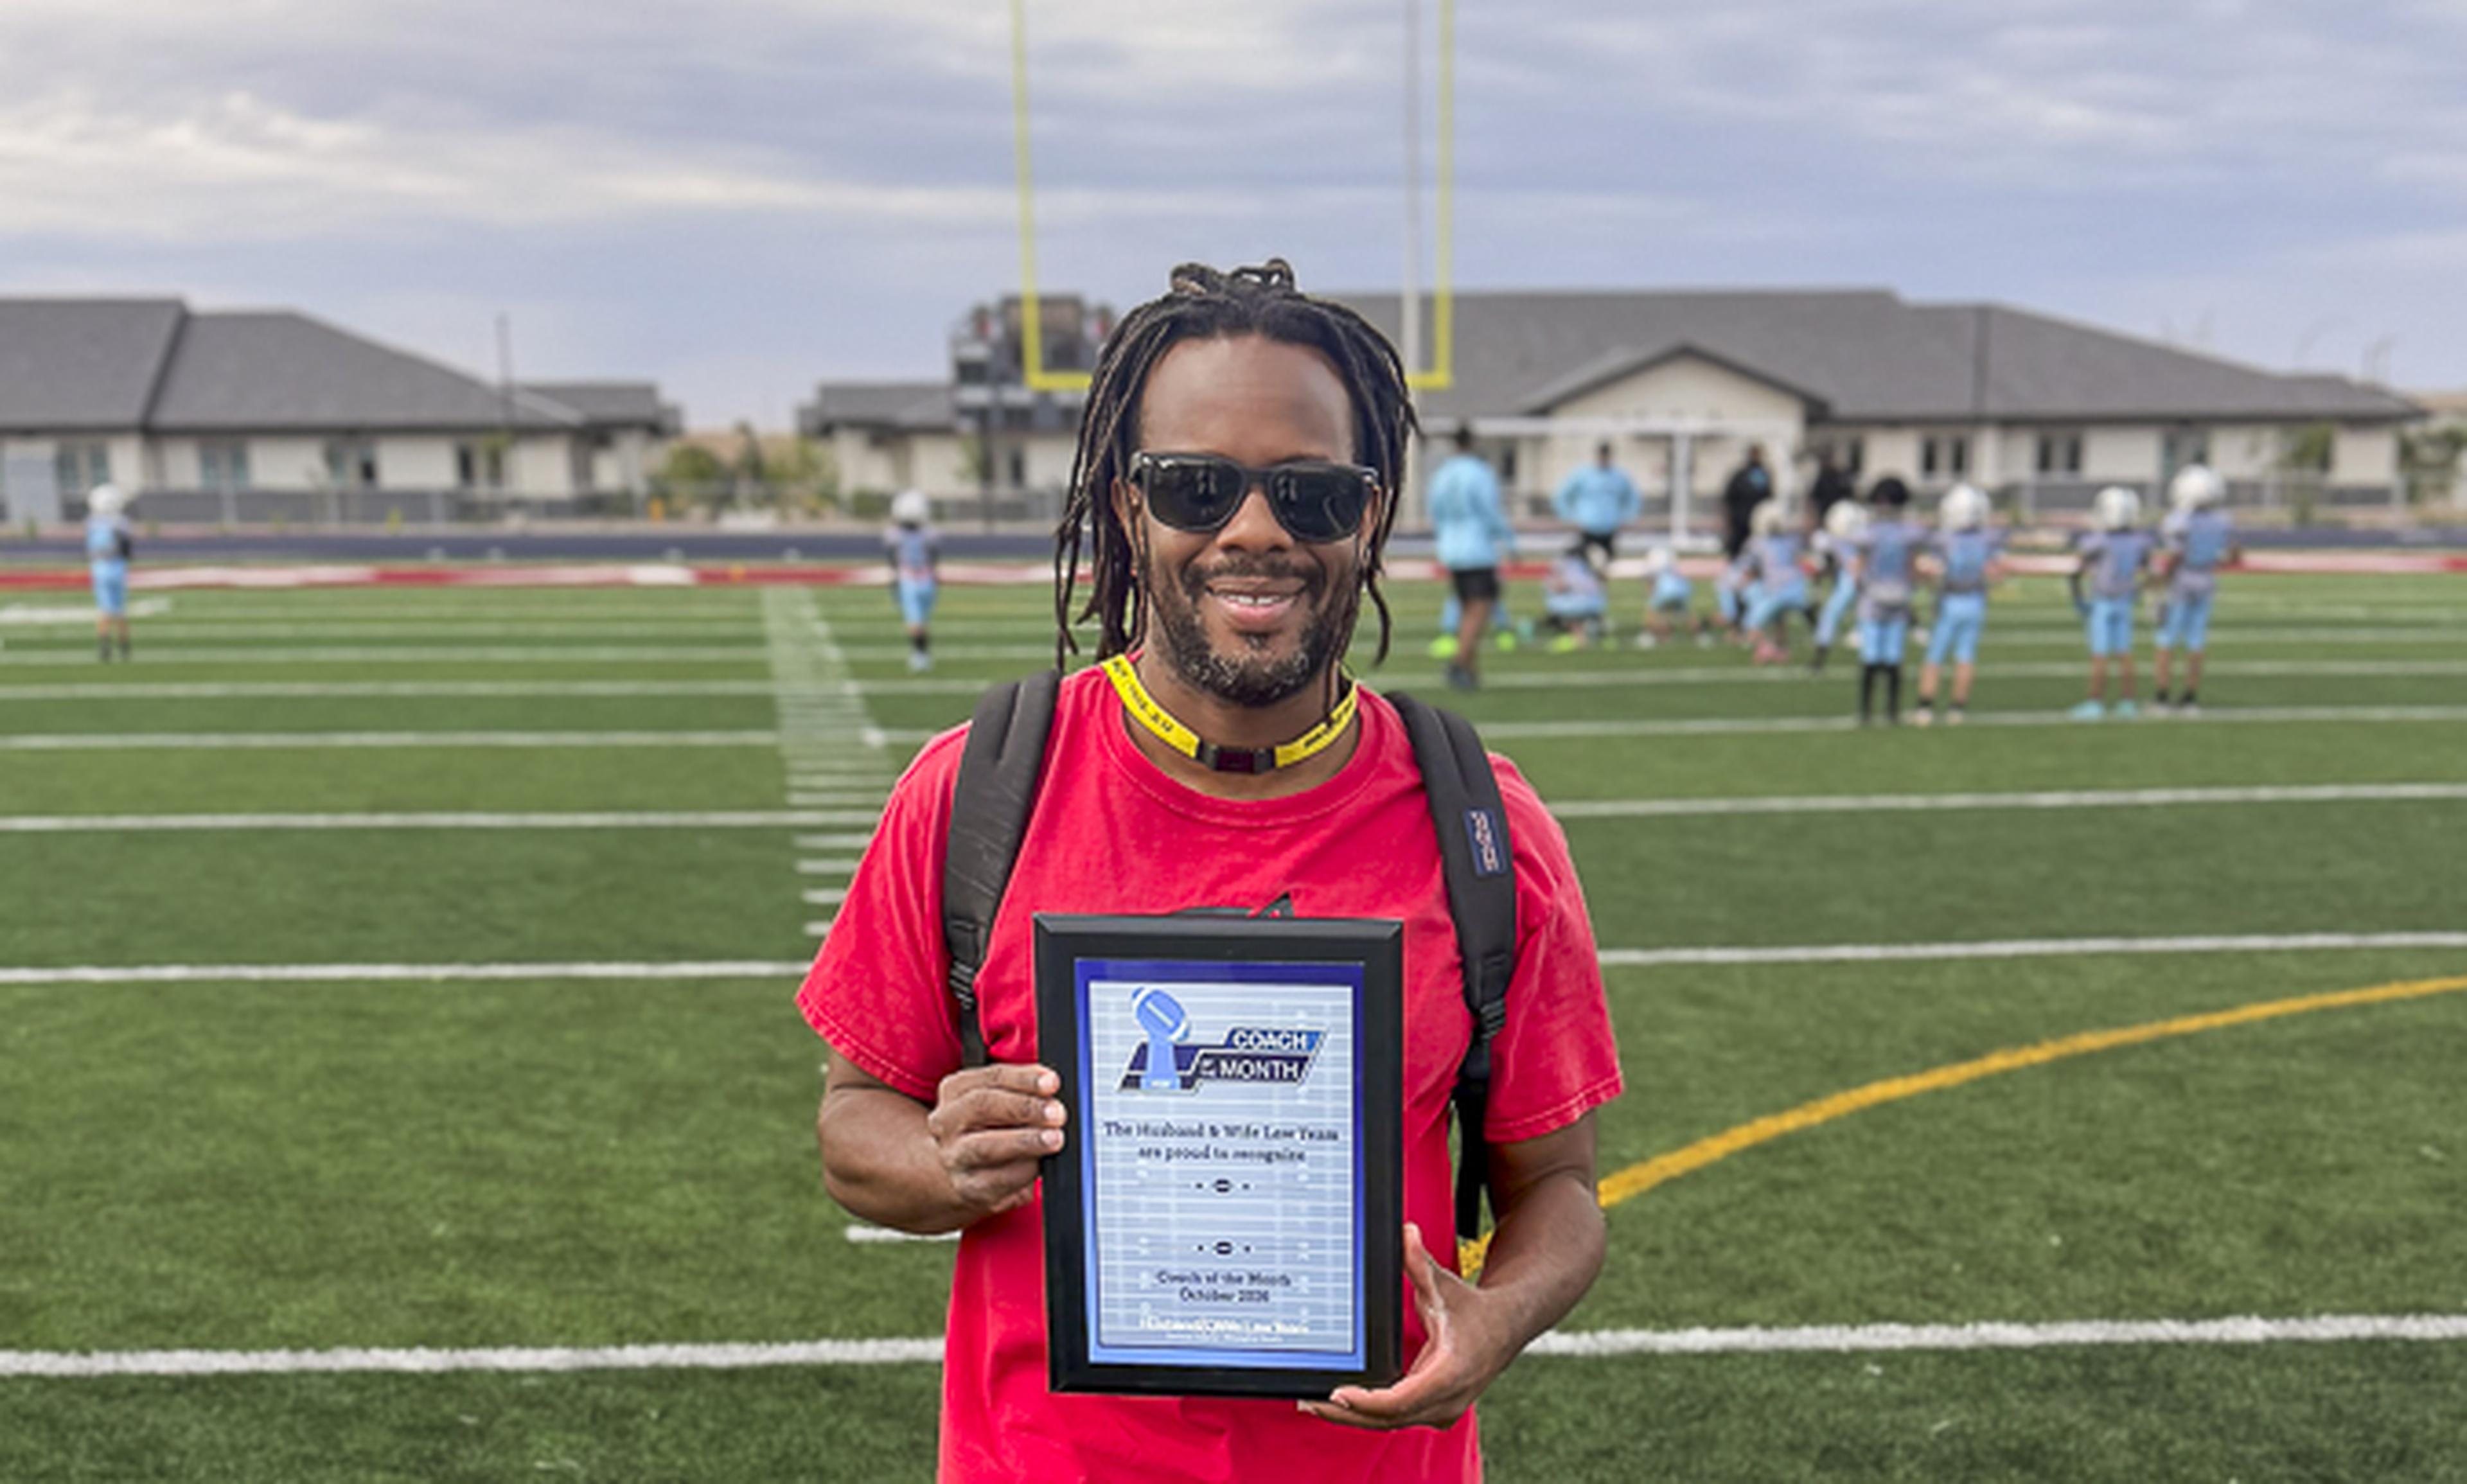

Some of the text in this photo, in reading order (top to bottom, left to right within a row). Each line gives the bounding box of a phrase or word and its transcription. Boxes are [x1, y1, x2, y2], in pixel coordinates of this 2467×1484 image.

[1232, 1030, 1307, 1050] COACH
[1219, 1058, 1299, 1079] MONTH
[1104, 1121, 1132, 1136] The
[1138, 1147, 1162, 1158] are
[1165, 1144, 1210, 1162] proud
